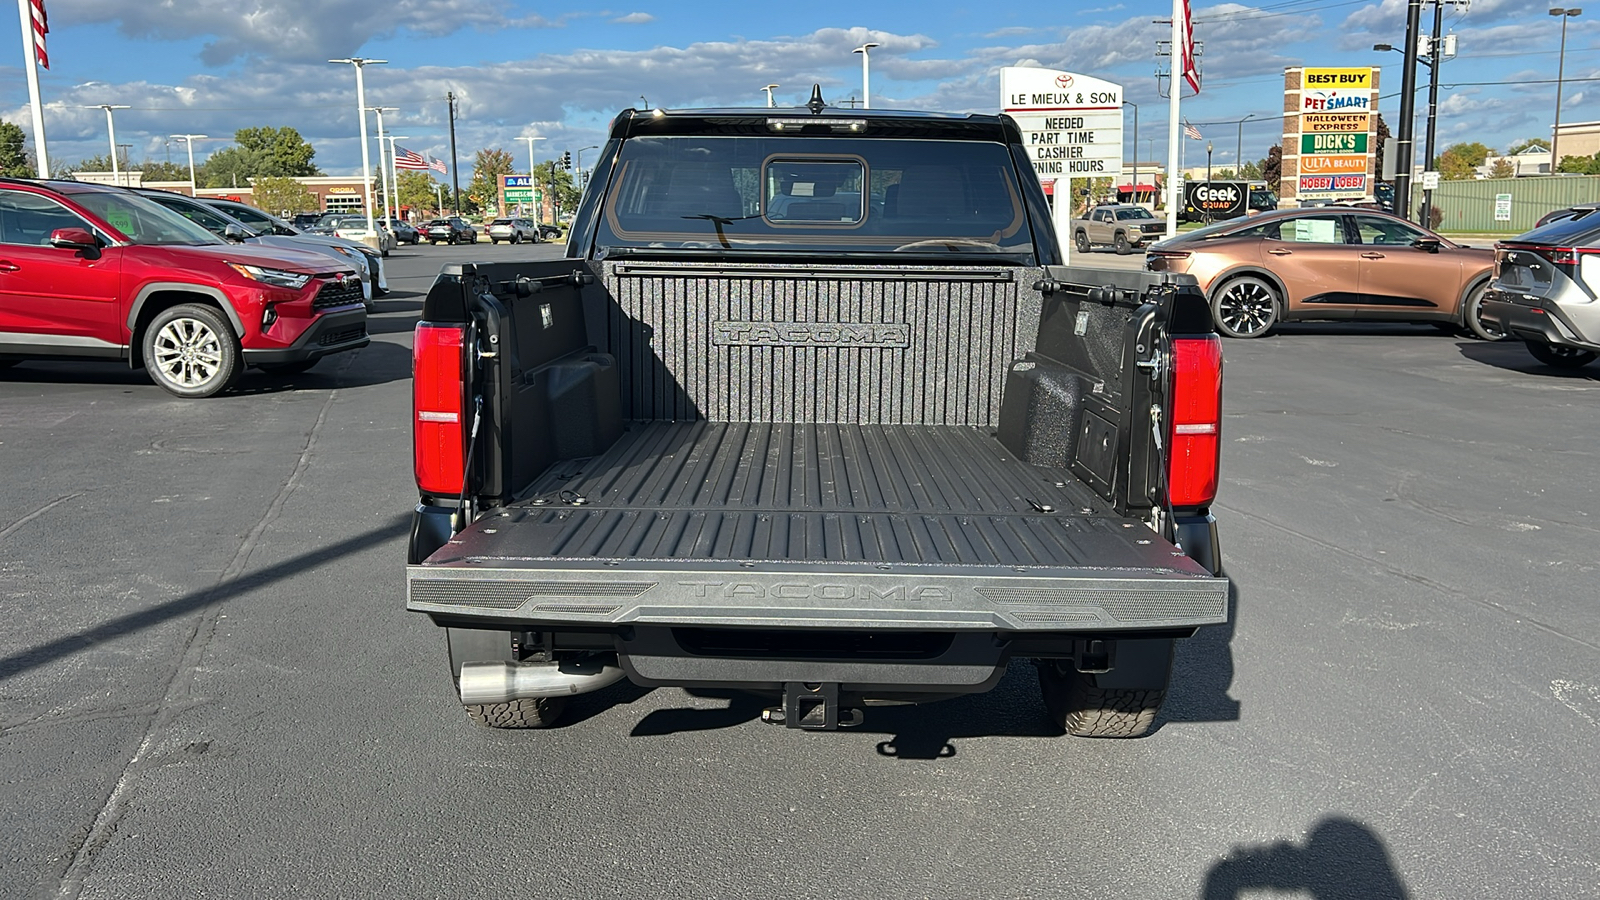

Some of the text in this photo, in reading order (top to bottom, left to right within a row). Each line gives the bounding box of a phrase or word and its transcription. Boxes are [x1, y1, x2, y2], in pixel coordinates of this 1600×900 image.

[1308, 74, 1367, 83] BEST BUY
[1011, 92, 1117, 105] LE MIEUX & SON
[1045, 117, 1084, 129] NEEDED
[1031, 132, 1094, 144] PART TIME
[1314, 134, 1355, 149] DICK'S
[1037, 146, 1083, 159] CASHIER
[1069, 160, 1104, 172] HOURS
[1305, 158, 1366, 169] ULTA BEAUTY
[1300, 176, 1364, 189] HOBBY LOBBY
[1196, 186, 1238, 201] Geek
[1202, 201, 1231, 209] SQUAD
[718, 326, 905, 344] TACOMA
[677, 581, 953, 602] TACOMA
